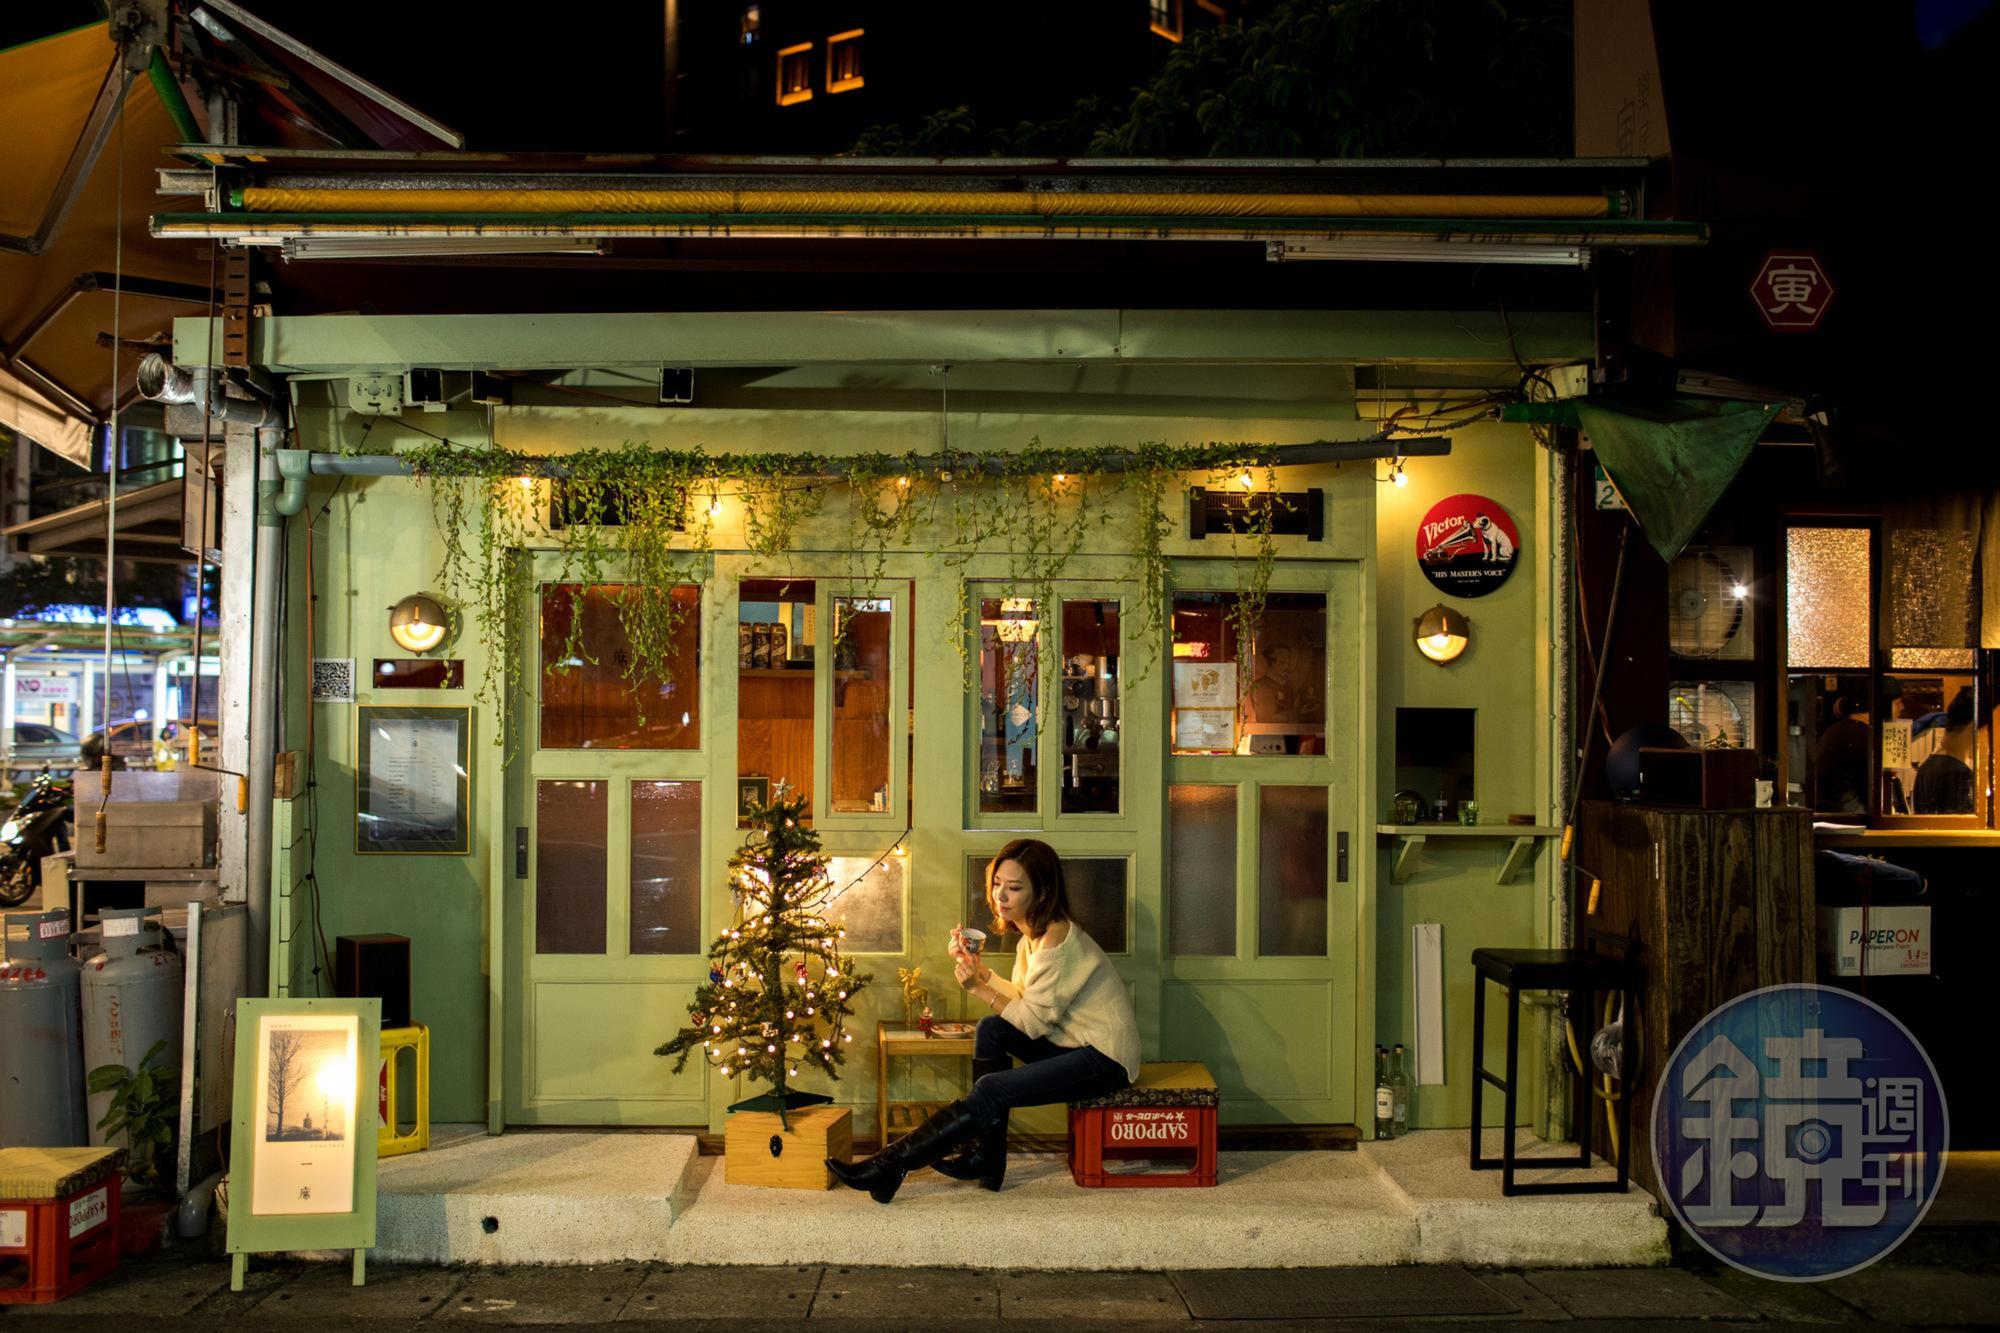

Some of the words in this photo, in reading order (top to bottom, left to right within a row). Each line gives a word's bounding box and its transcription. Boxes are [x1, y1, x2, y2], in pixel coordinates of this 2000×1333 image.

[1767, 263, 1818, 315] 寅
[1423, 515, 1465, 547] Victor
[1849, 928, 1920, 945] PAPERON
[1110, 1122, 1189, 1141] SAPPORO
